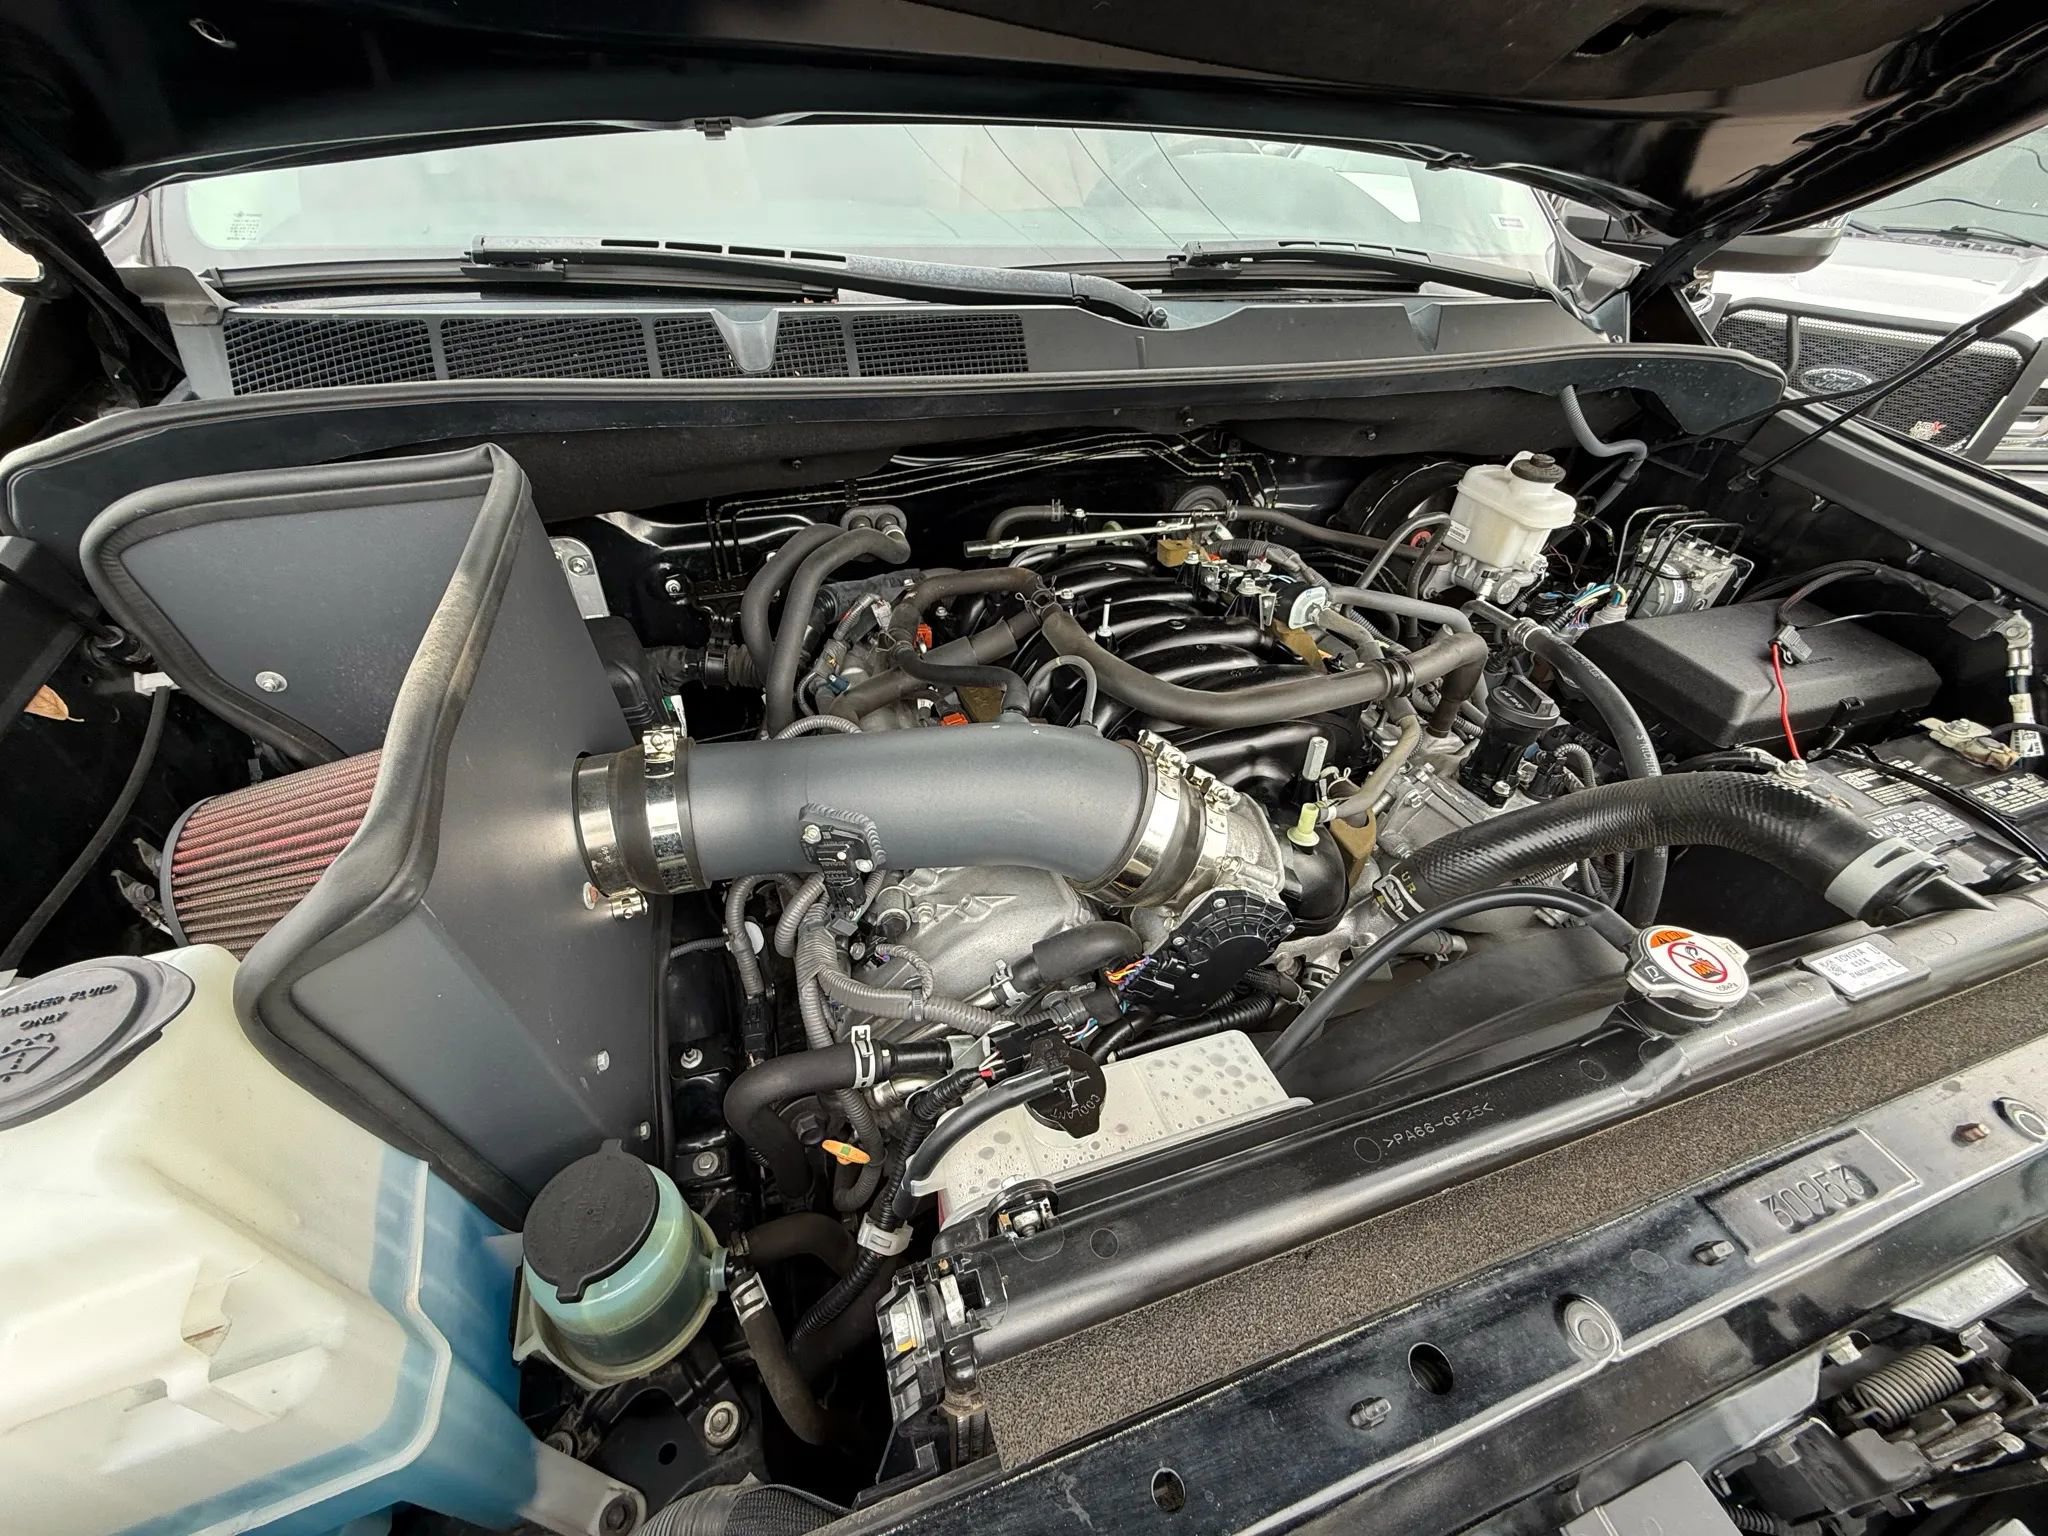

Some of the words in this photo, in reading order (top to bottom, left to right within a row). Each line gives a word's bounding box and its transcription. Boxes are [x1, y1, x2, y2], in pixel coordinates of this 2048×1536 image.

[1834, 946, 1867, 962] TOYOTA
[68, 984, 118, 1002] FLUID
[19, 1011, 69, 1030] ONLY
[1050, 1094, 1101, 1120] COOLANT
[1756, 1163, 1868, 1232] 30953
